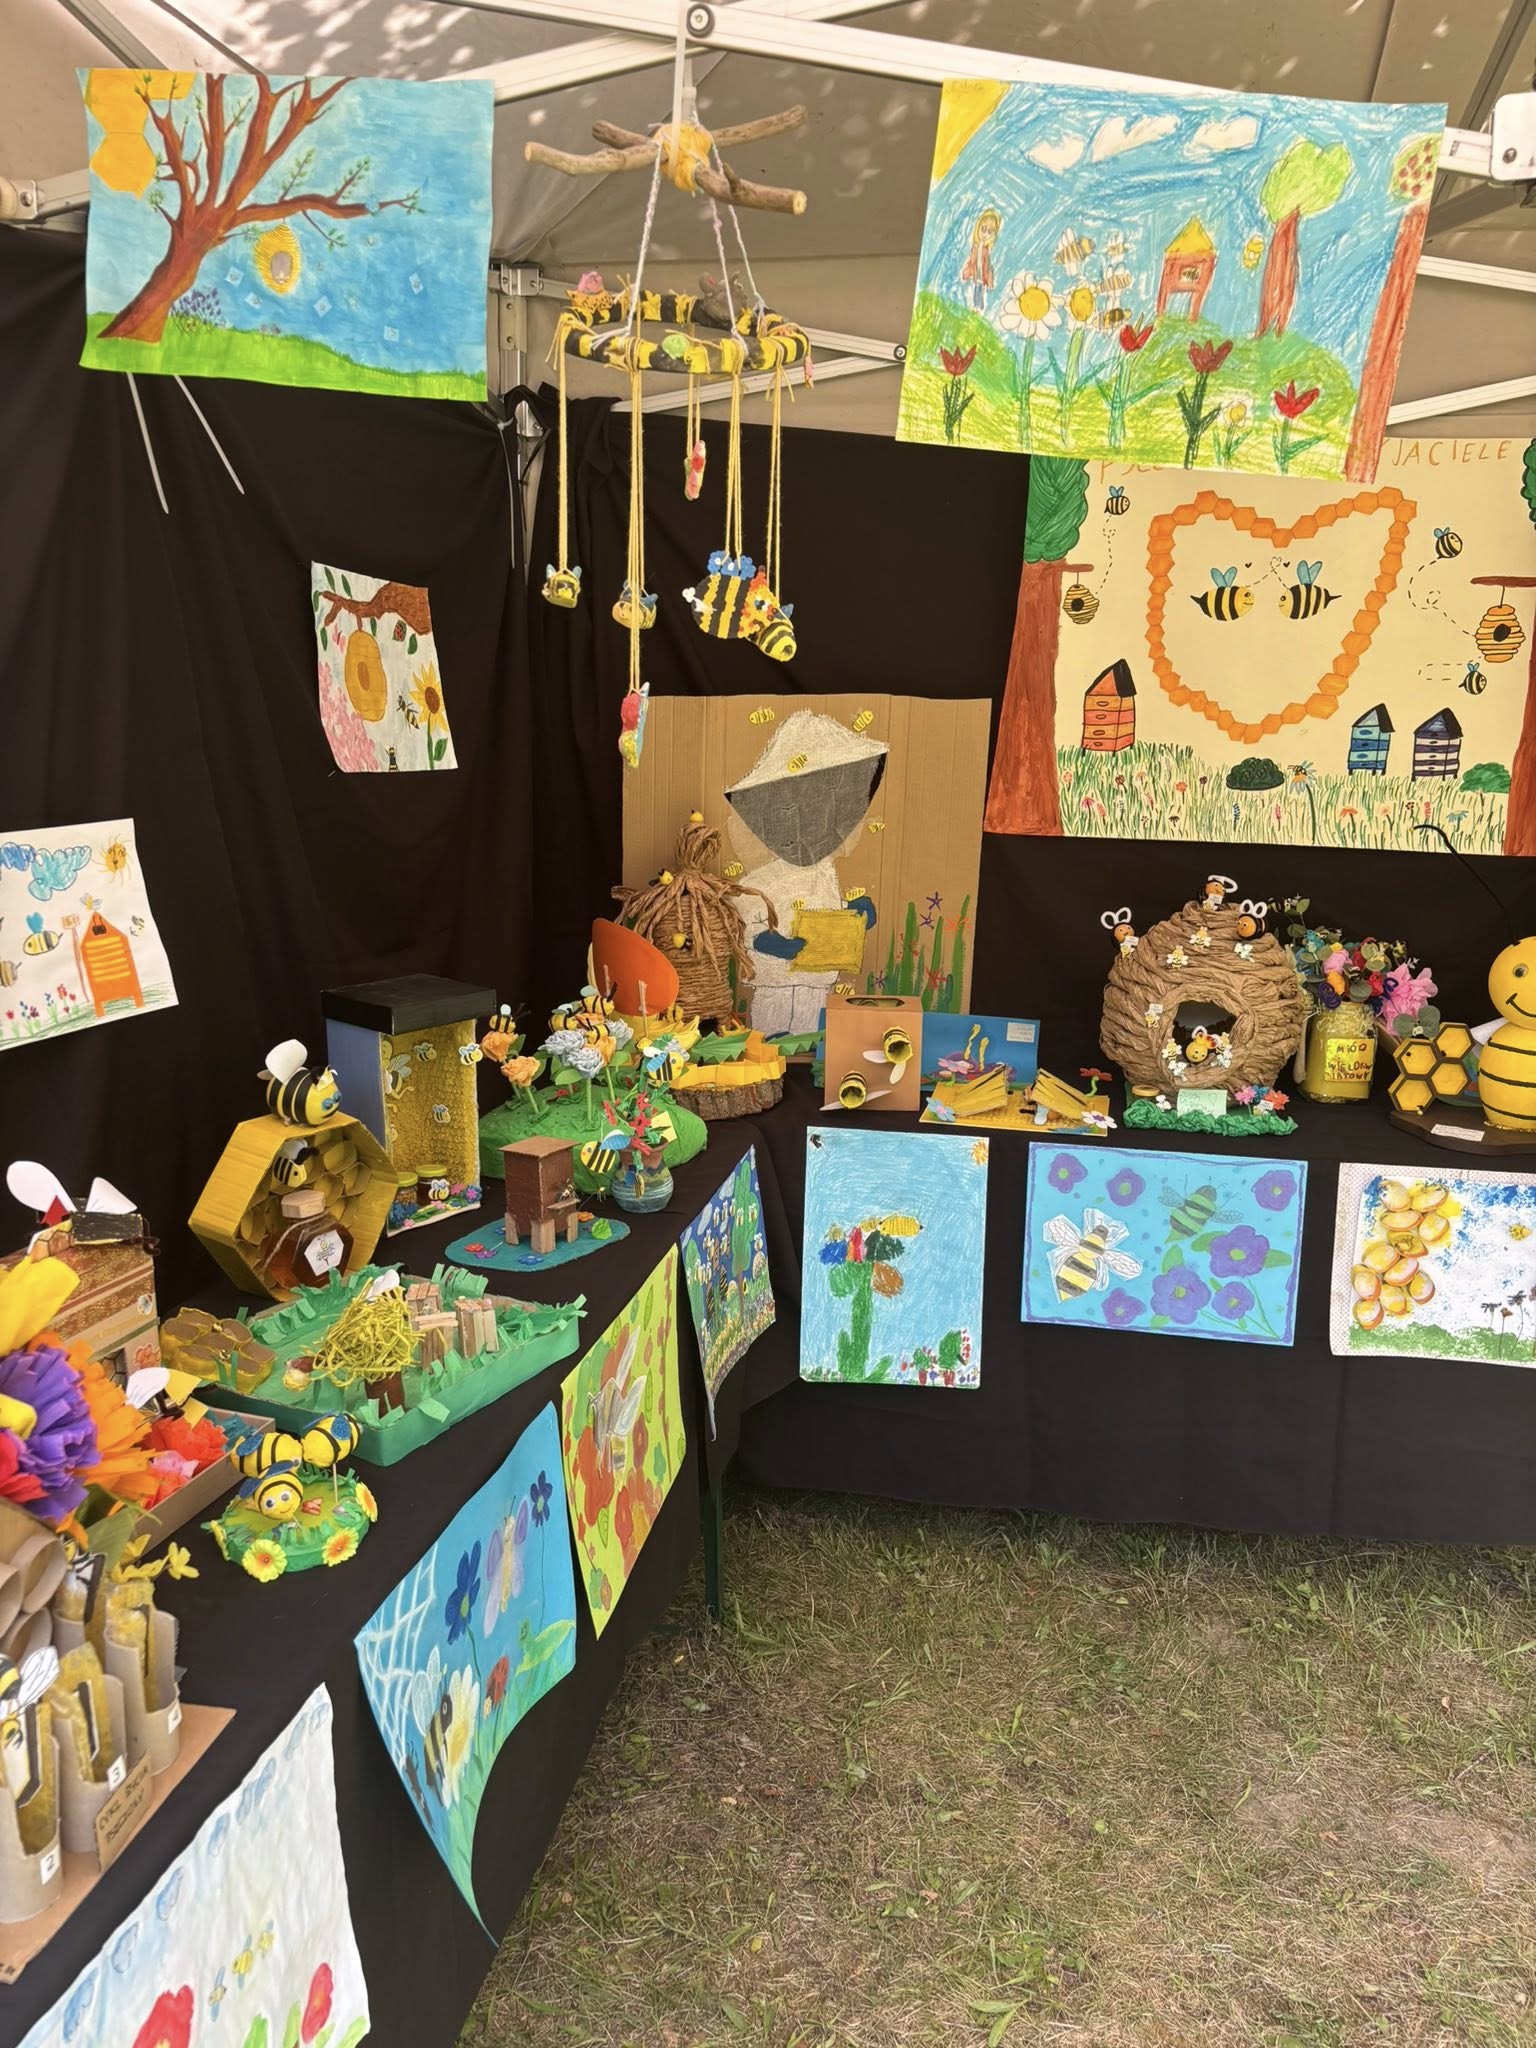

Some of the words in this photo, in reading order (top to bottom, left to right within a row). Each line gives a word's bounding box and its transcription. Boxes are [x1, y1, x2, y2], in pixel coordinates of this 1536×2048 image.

[1381, 438, 1512, 466] JACIELE
[111, 1766, 121, 1784] 3
[45, 1854, 55, 1872] 2
